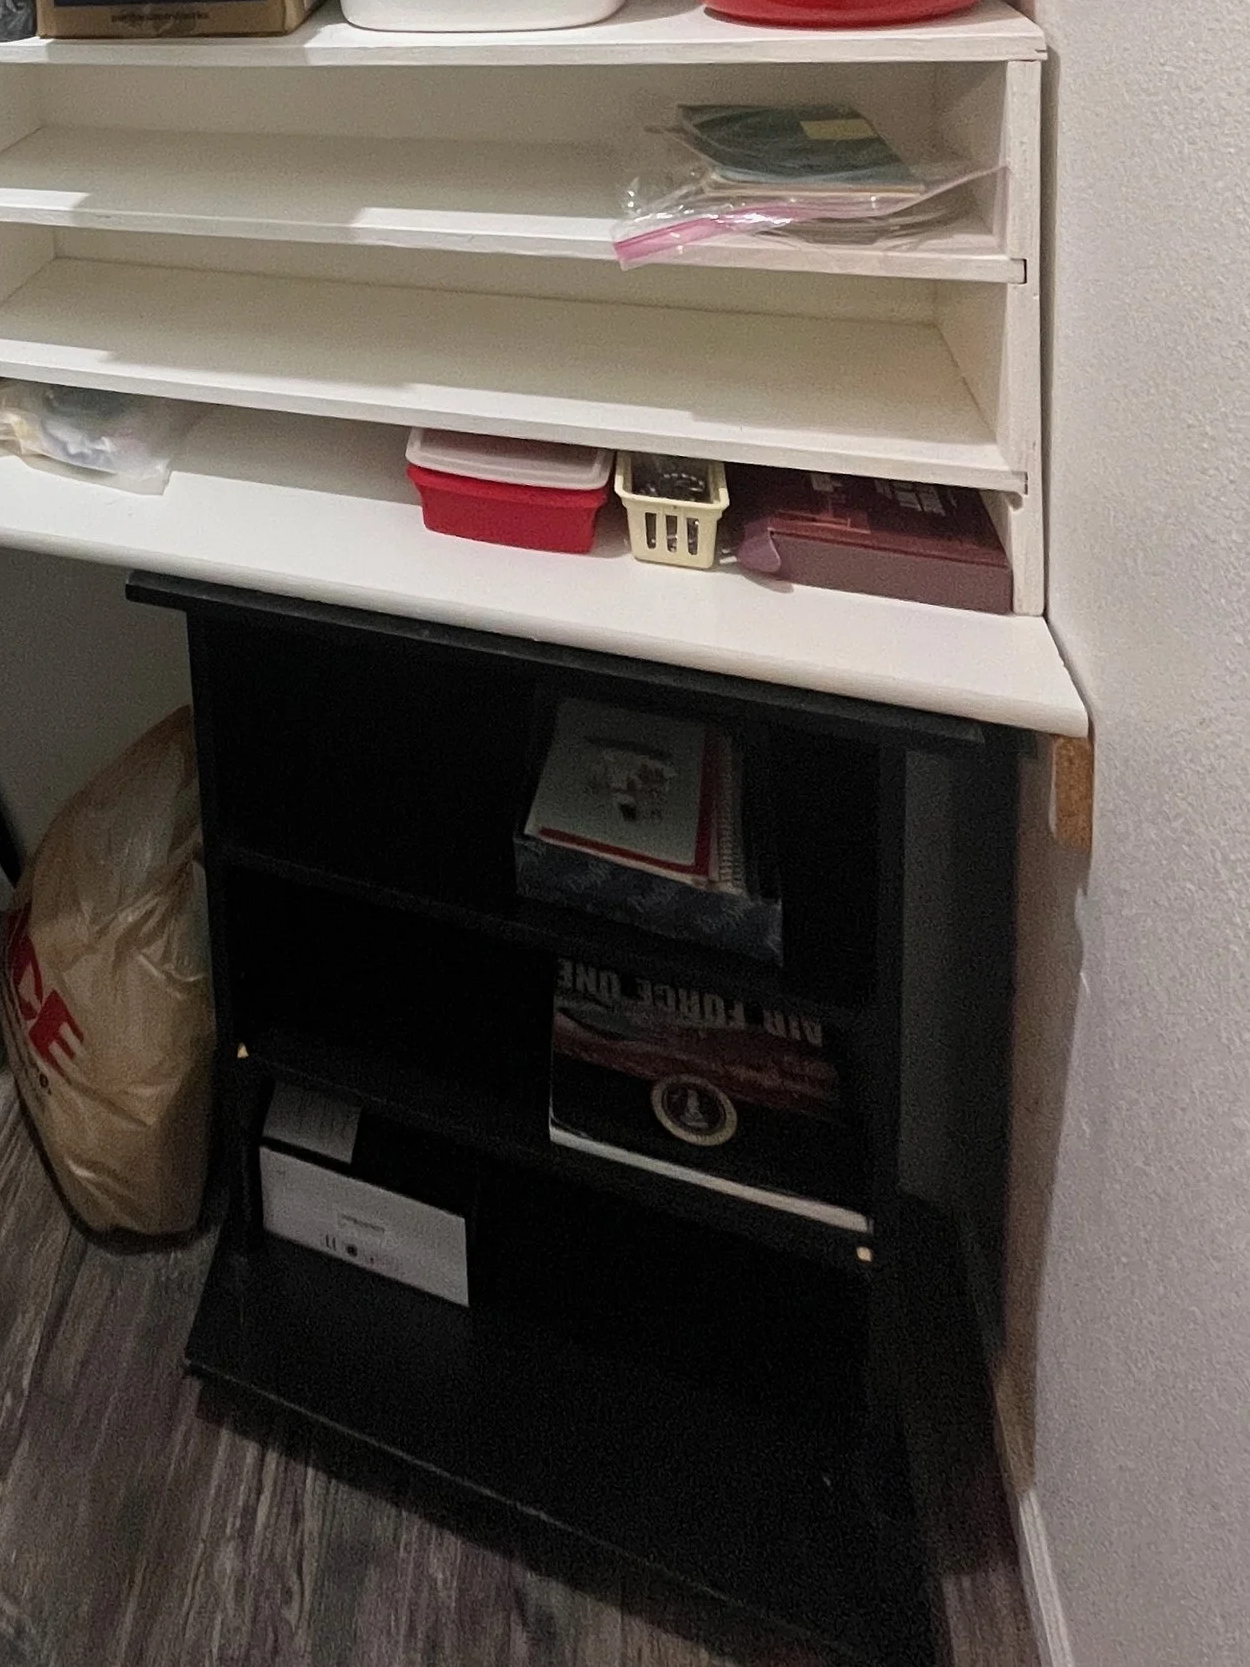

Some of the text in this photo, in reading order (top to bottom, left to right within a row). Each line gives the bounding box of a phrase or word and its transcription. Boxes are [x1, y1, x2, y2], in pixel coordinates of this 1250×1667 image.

[555, 957, 824, 1047] AIR FORCE ONE
